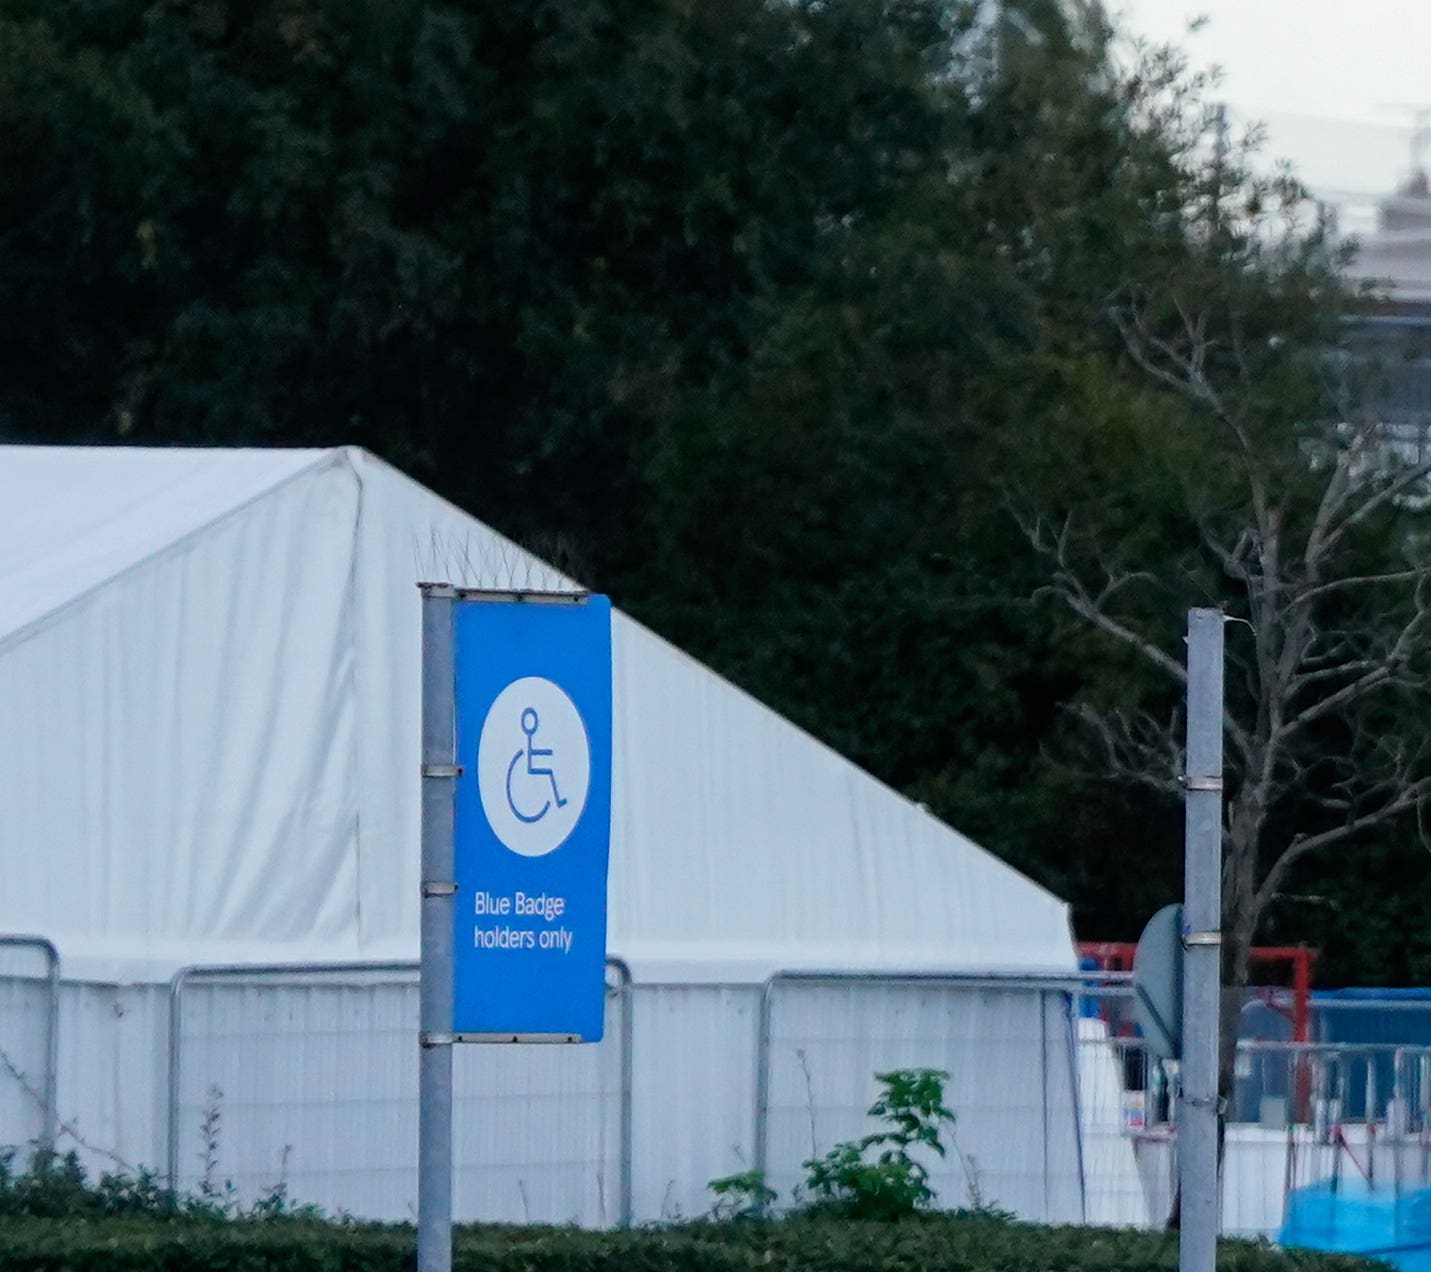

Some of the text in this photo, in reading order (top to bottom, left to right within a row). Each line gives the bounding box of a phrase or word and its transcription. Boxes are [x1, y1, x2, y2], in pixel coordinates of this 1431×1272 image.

[475, 891, 565, 921] Blue Badge
[474, 925, 573, 955] holders only
